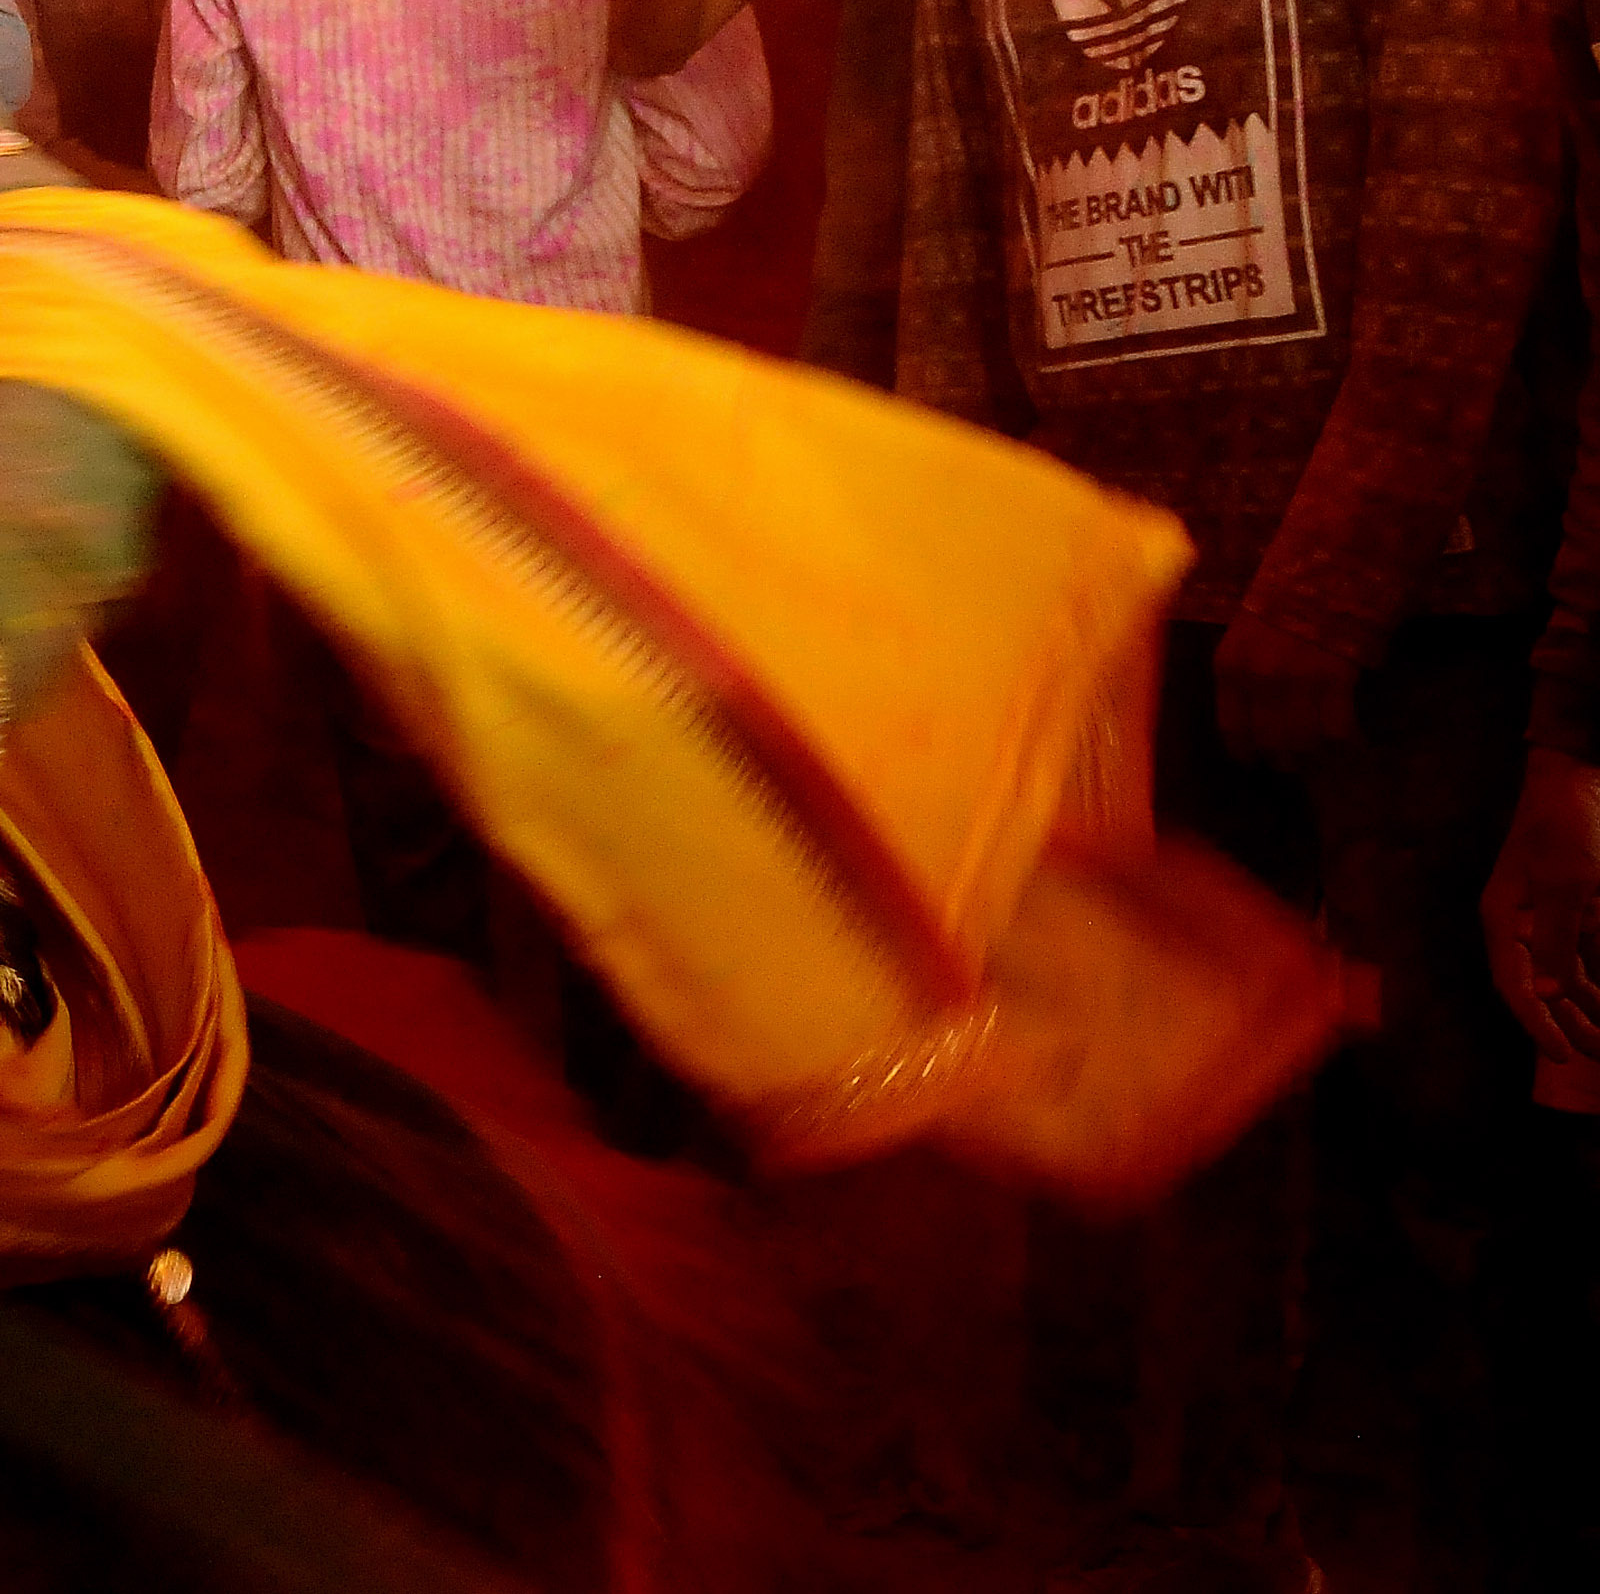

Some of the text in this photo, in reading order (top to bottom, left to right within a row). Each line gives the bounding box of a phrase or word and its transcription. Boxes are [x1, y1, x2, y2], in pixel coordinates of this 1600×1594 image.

[1072, 64, 1206, 129] adidas
[1086, 181, 1181, 227] BRAND
[1118, 230, 1174, 268] THE
